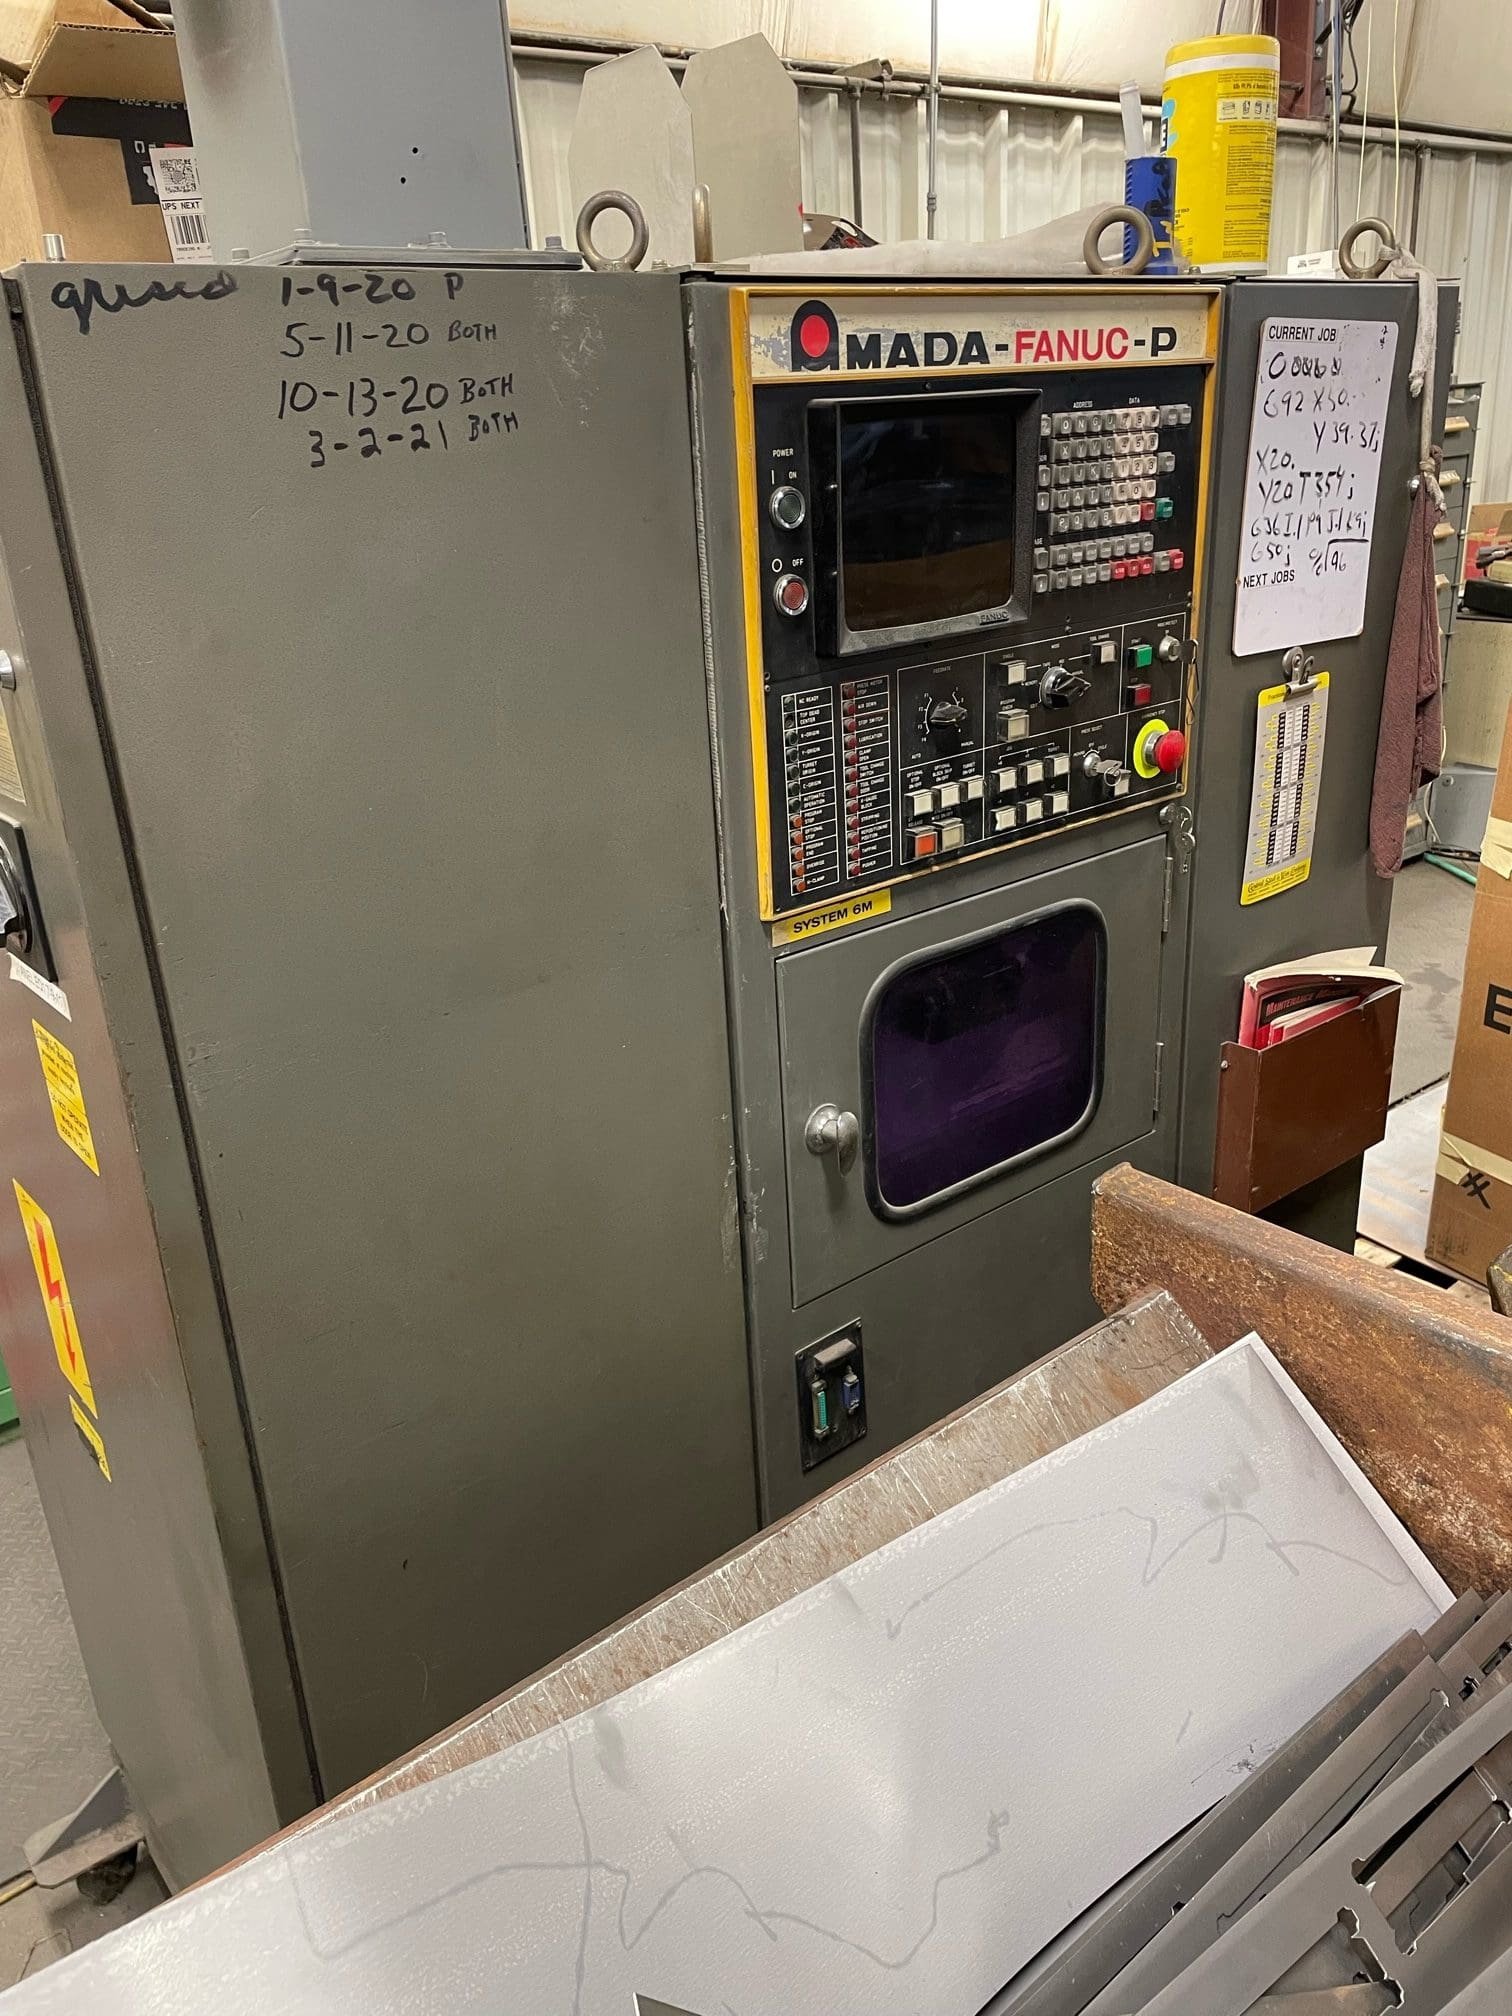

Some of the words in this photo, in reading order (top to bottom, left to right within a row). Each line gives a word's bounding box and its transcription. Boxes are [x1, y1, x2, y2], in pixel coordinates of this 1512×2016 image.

[162, 202, 177, 210] UPS
[180, 201, 200, 210] NEXT
[282, 273, 416, 306] 1-9-20
[443, 272, 464, 300] P
[280, 322, 429, 357] 5-11-20
[1268, 325, 1315, 341] CURRENT
[1317, 328, 1337, 342] JOB
[278, 376, 449, 420] 10-13-20
[308, 420, 448, 468] 3-2-21
[772, 448, 794, 458] POWER
[788, 471, 798, 480] ON
[792, 558, 804, 567] OFF
[1243, 573, 1268, 589] NEXT
[1271, 569, 1295, 584] JOBS
[980, 611, 1009, 623] FANUC
[859, 733, 883, 742] LUBRICATION
[803, 792, 826, 802] AUTOMATIC
[804, 810, 823, 818] PROGRAM
[793, 907, 848, 933] SYSTEM
[852, 900, 873, 915] 6M
[1266, 994, 1313, 1016] MAINTENANCE
